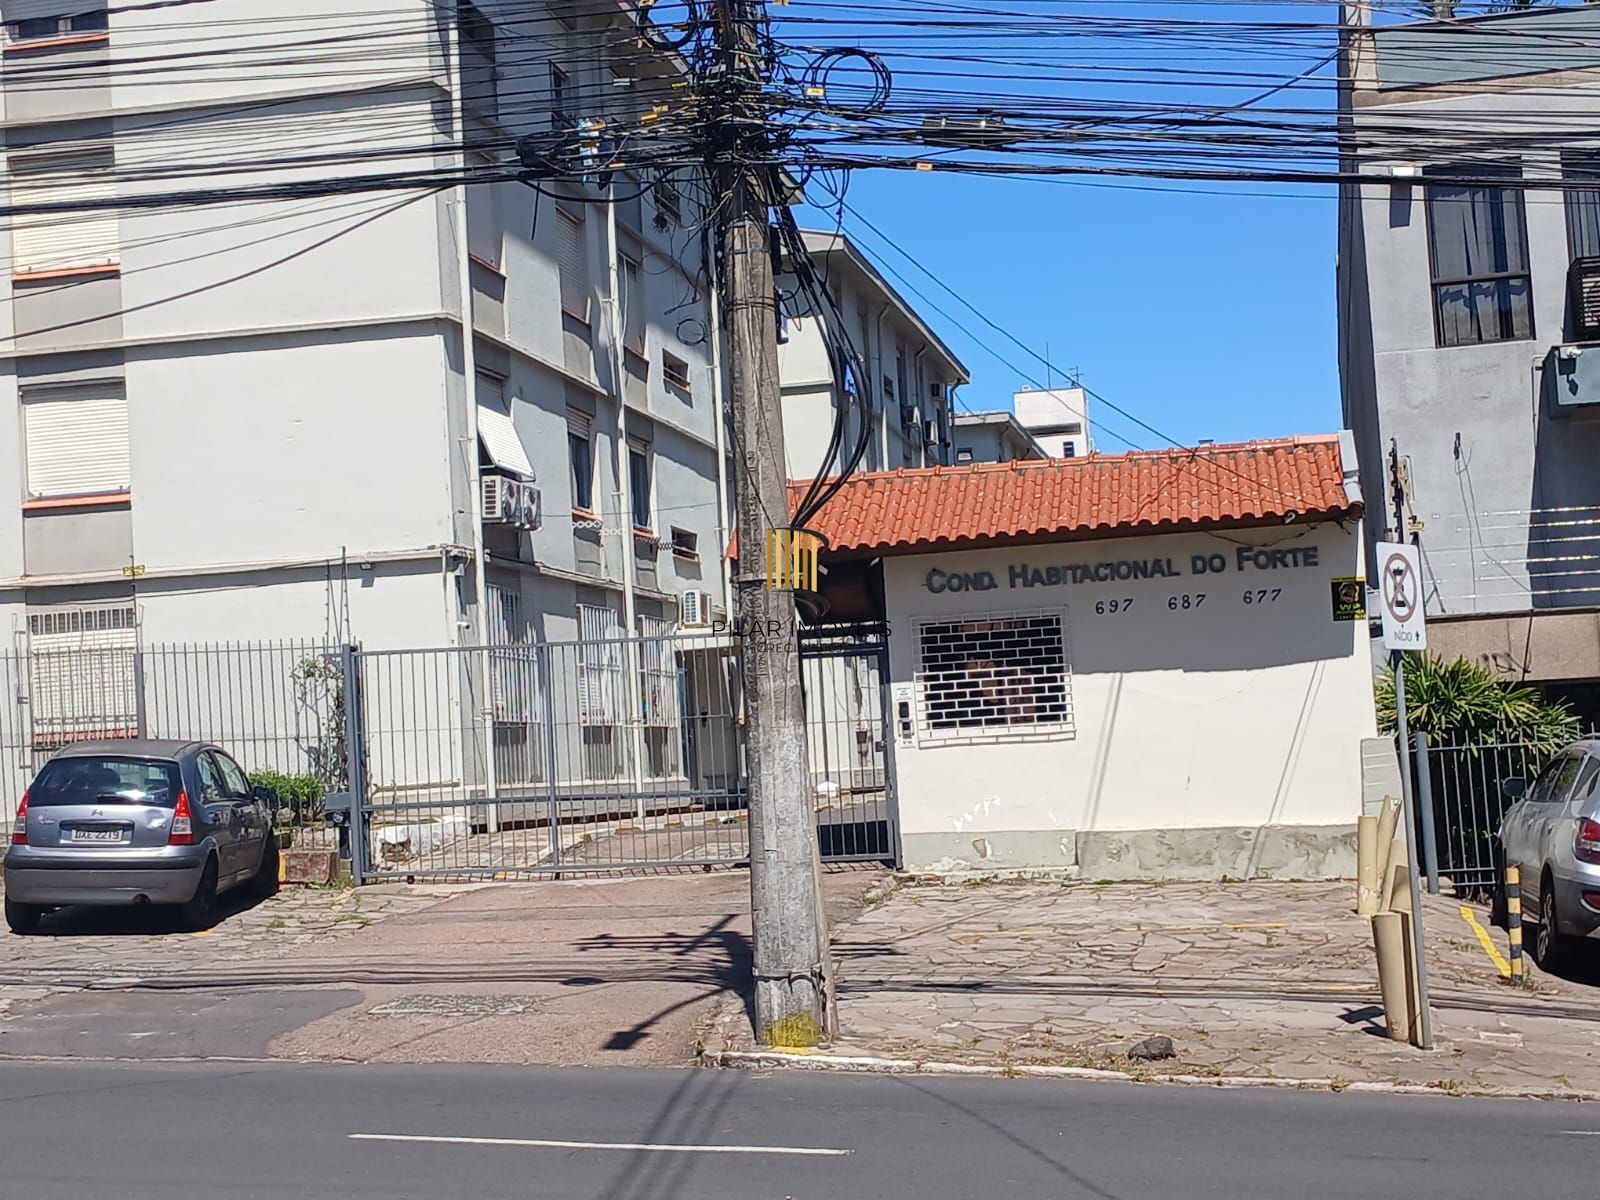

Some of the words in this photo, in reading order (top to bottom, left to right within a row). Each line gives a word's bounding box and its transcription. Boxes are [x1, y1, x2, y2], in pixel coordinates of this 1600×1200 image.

[1008, 559, 1181, 588] HABITACIONAL
[1191, 554, 1226, 574] DO
[1236, 546, 1319, 571] FORTE
[1095, 598, 1134, 614] 697
[1167, 594, 1206, 610] 687
[1242, 588, 1282, 604] 677
